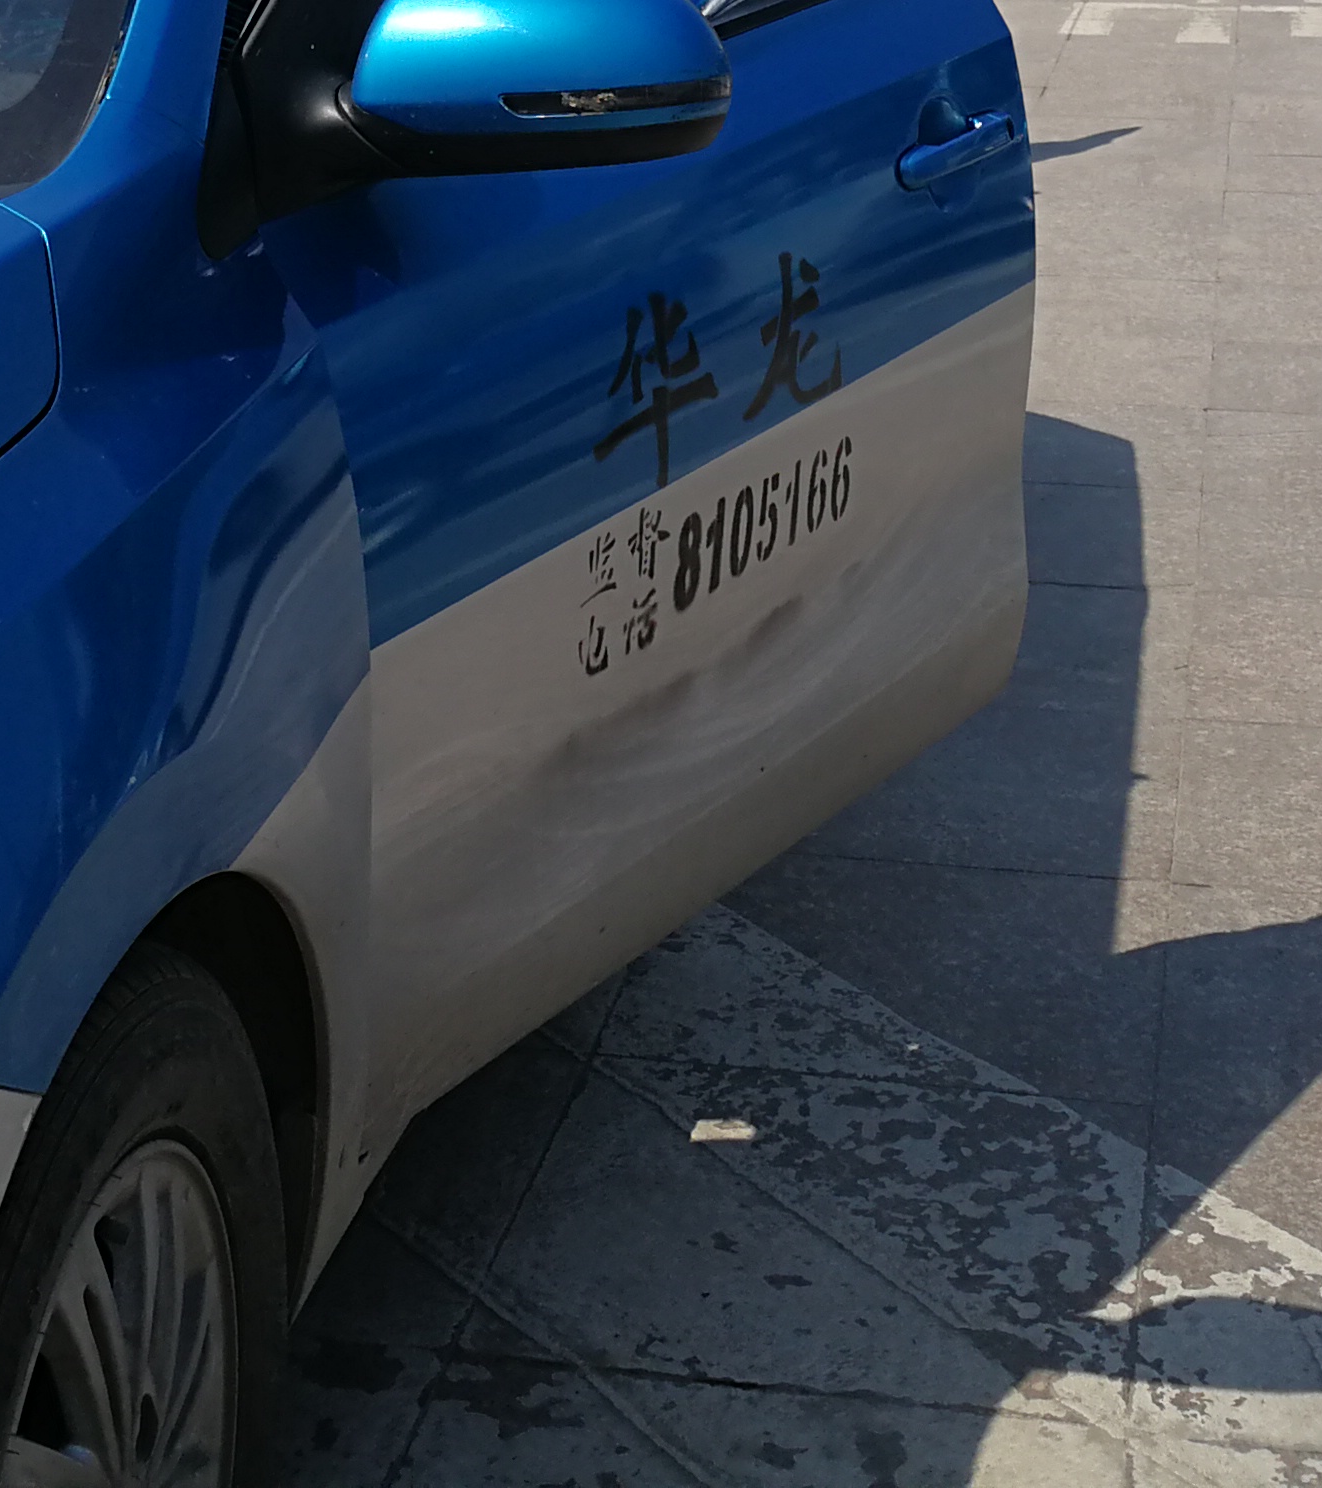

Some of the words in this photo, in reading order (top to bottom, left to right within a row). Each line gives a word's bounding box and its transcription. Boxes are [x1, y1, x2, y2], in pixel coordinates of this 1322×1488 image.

[593, 251, 842, 488] 华龙
[580, 507, 671, 608] 监督
[673, 435, 853, 613] 8105166
